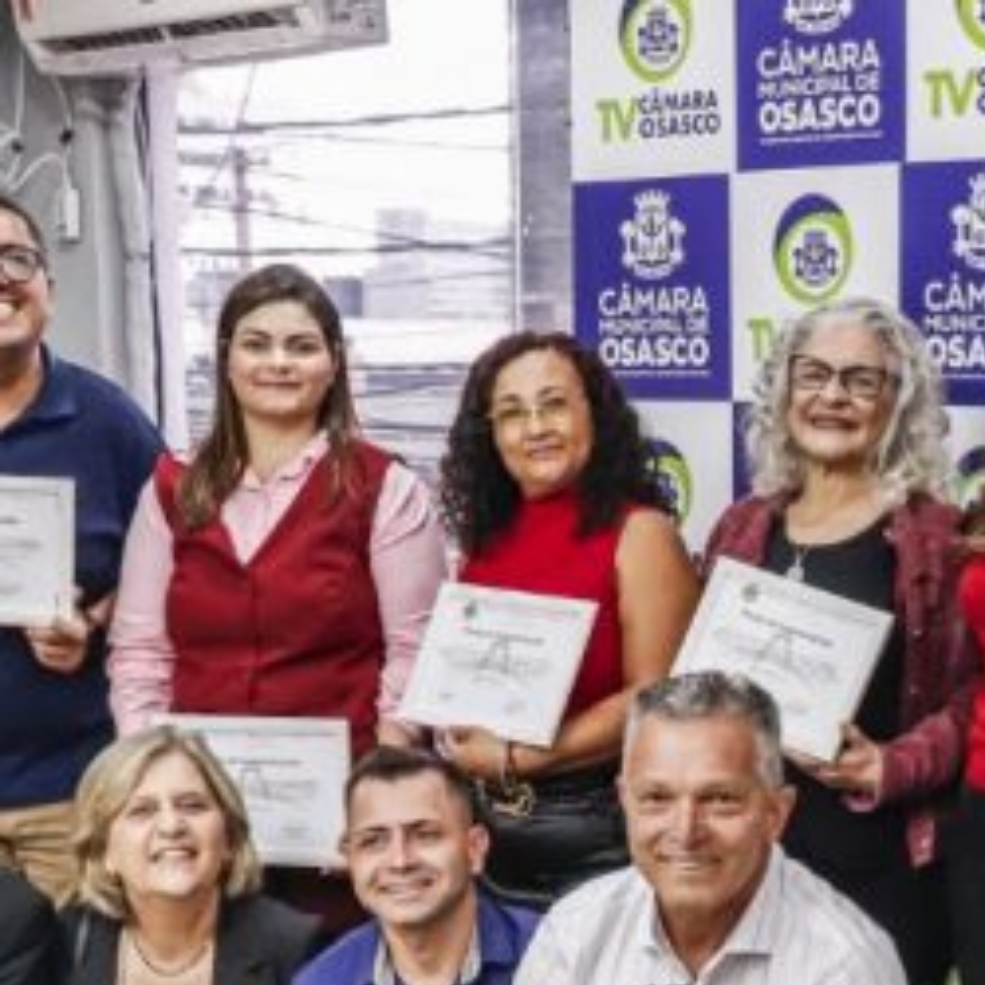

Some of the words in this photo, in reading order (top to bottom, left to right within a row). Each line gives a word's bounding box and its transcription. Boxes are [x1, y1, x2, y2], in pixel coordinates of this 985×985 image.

[757, 39, 880, 77] CÂMARA
[924, 68, 977, 118] TV
[595, 98, 638, 142] TV
[638, 112, 721, 138] OSASCO
[759, 94, 880, 134] OSASCO
[599, 282, 710, 316] CÂMARA
[599, 337, 710, 367] OSASCO
